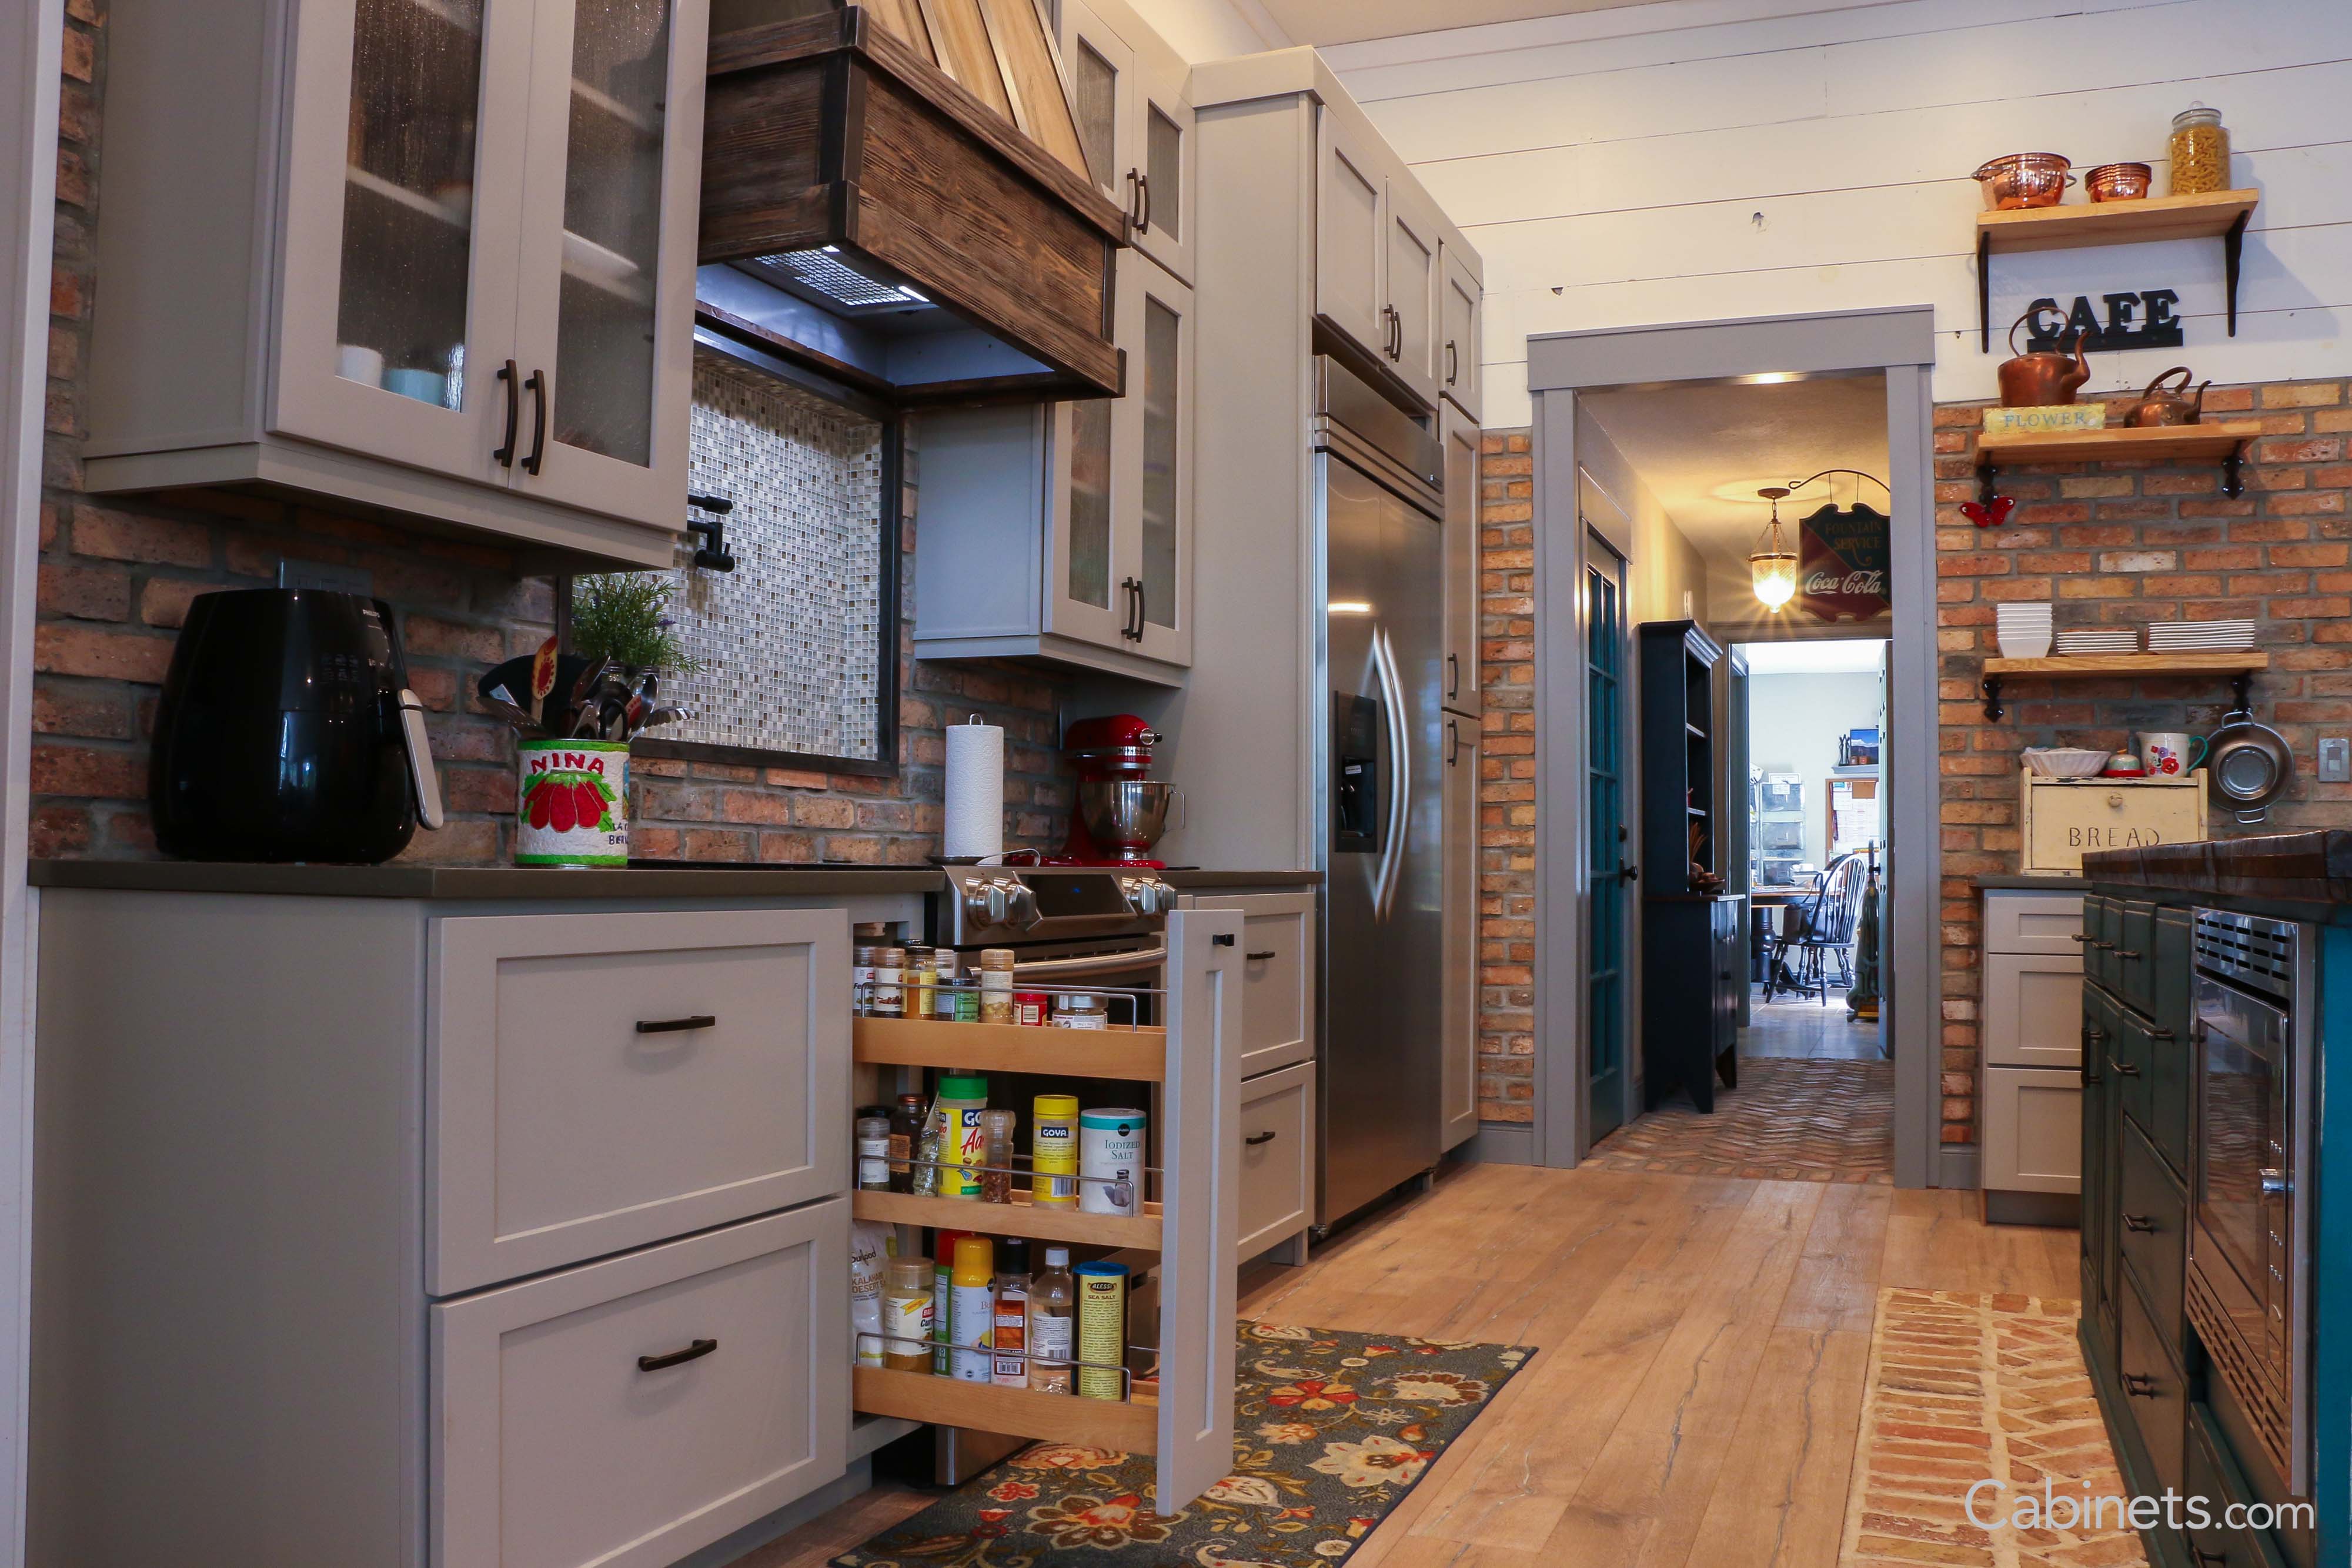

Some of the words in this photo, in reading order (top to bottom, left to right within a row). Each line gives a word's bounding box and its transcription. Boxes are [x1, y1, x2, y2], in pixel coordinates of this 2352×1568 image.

[2027, 289, 2180, 339] CAFE
[2004, 411, 2088, 429] FLOWER
[1825, 520, 1882, 535] FOUNTAIN
[1834, 536, 1882, 550] SERVICE
[530, 753, 604, 774] NINA
[2068, 827, 2160, 847] BREAD
[1043, 1129, 1067, 1138] GOYA
[1105, 1139, 1140, 1149] IODIZED
[1111, 1150, 1134, 1160] SALT
